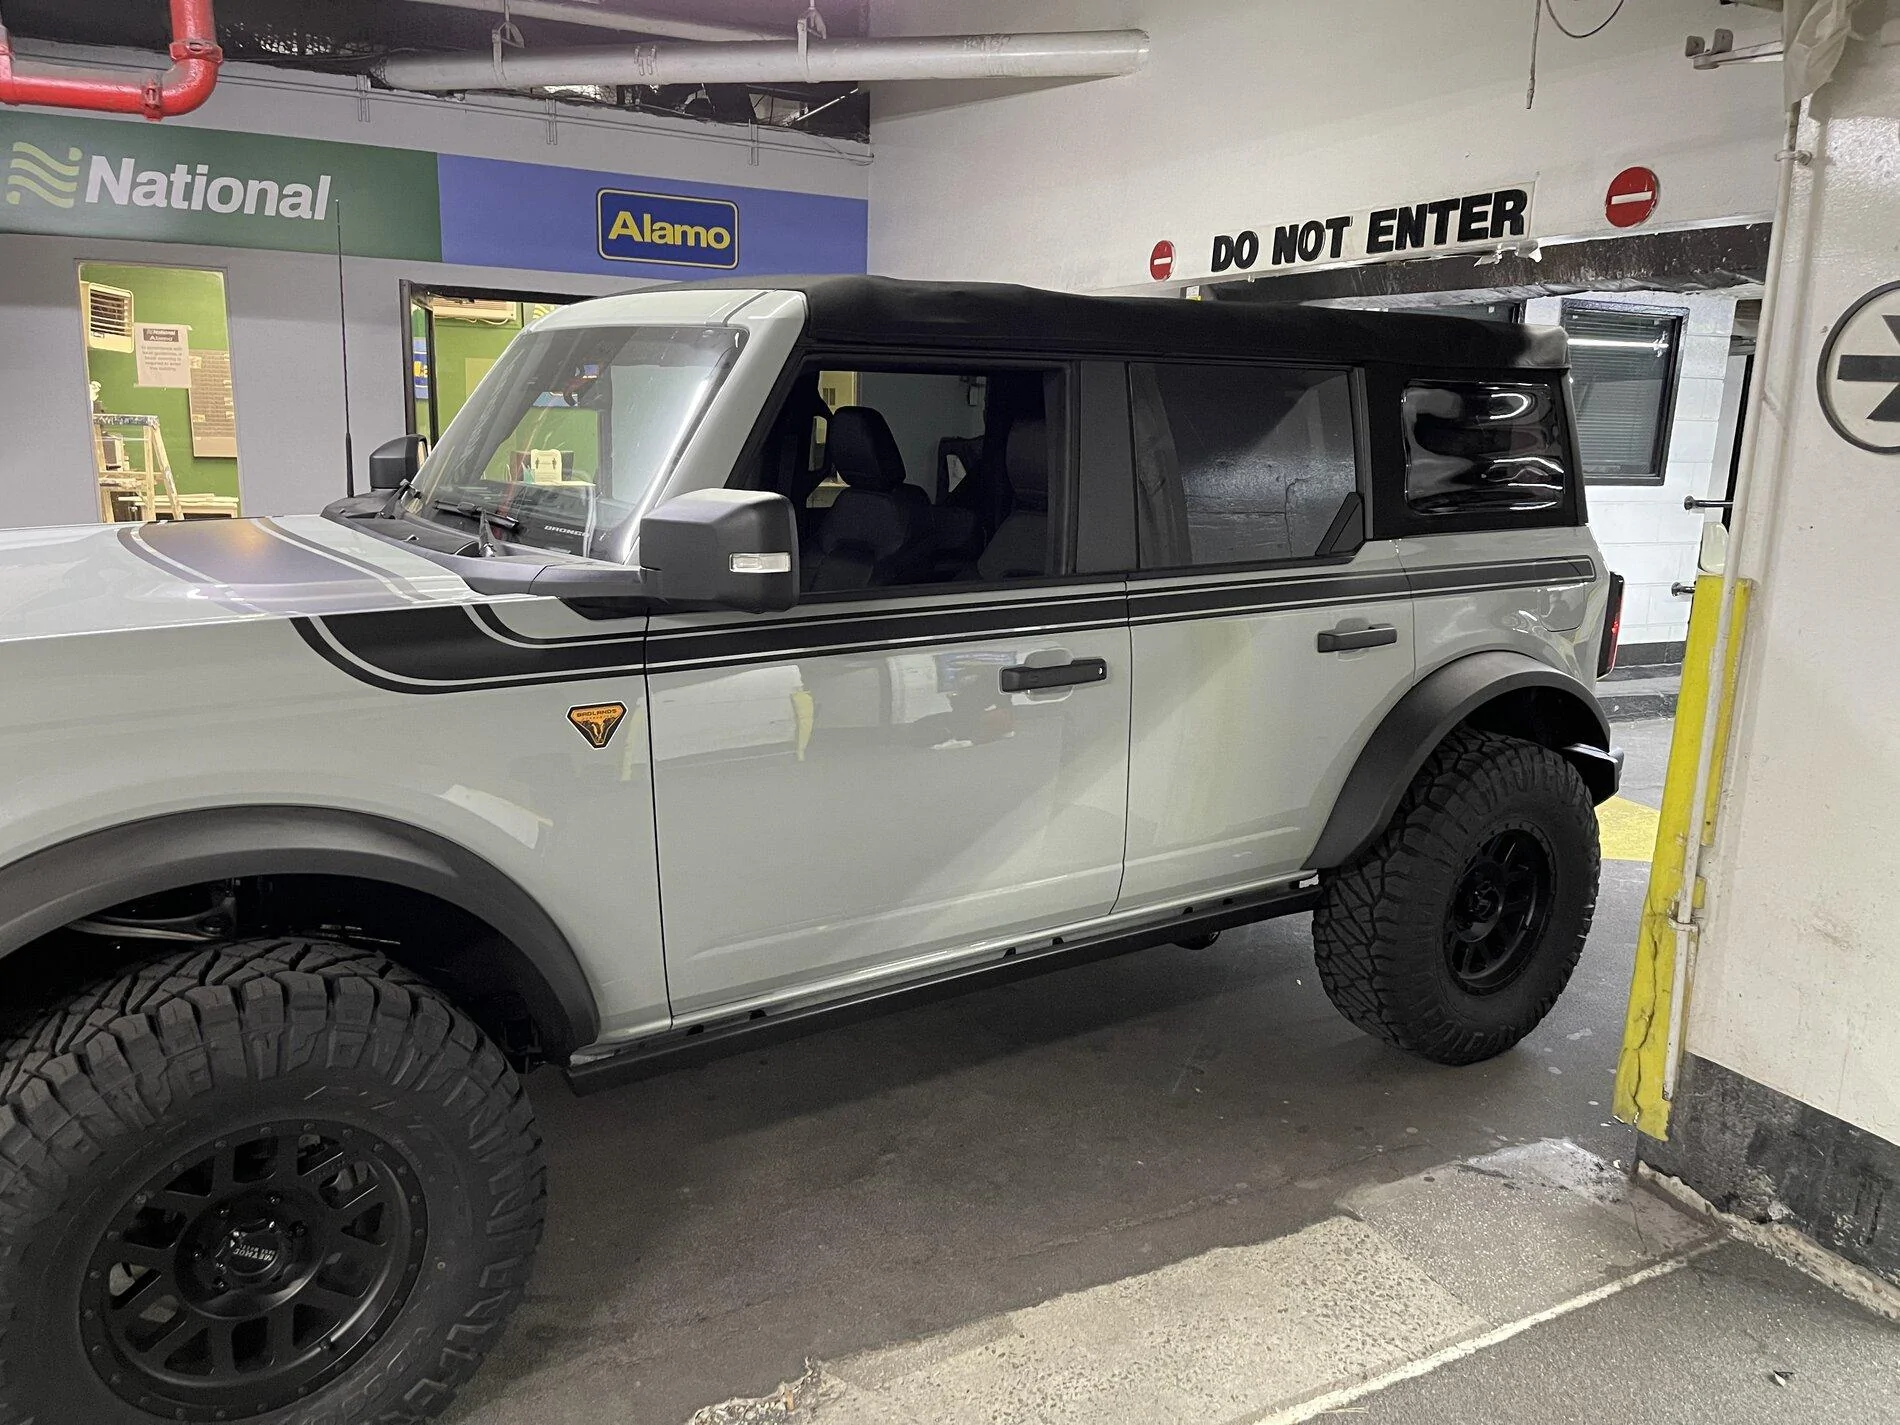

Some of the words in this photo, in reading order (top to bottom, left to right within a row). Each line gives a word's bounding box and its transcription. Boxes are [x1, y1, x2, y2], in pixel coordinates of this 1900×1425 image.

[85, 155, 331, 220] National
[608, 210, 731, 250] Alamo
[1210, 229, 1259, 272] DO
[1271, 215, 1353, 265] NOT
[1365, 188, 1529, 254] ENTER
